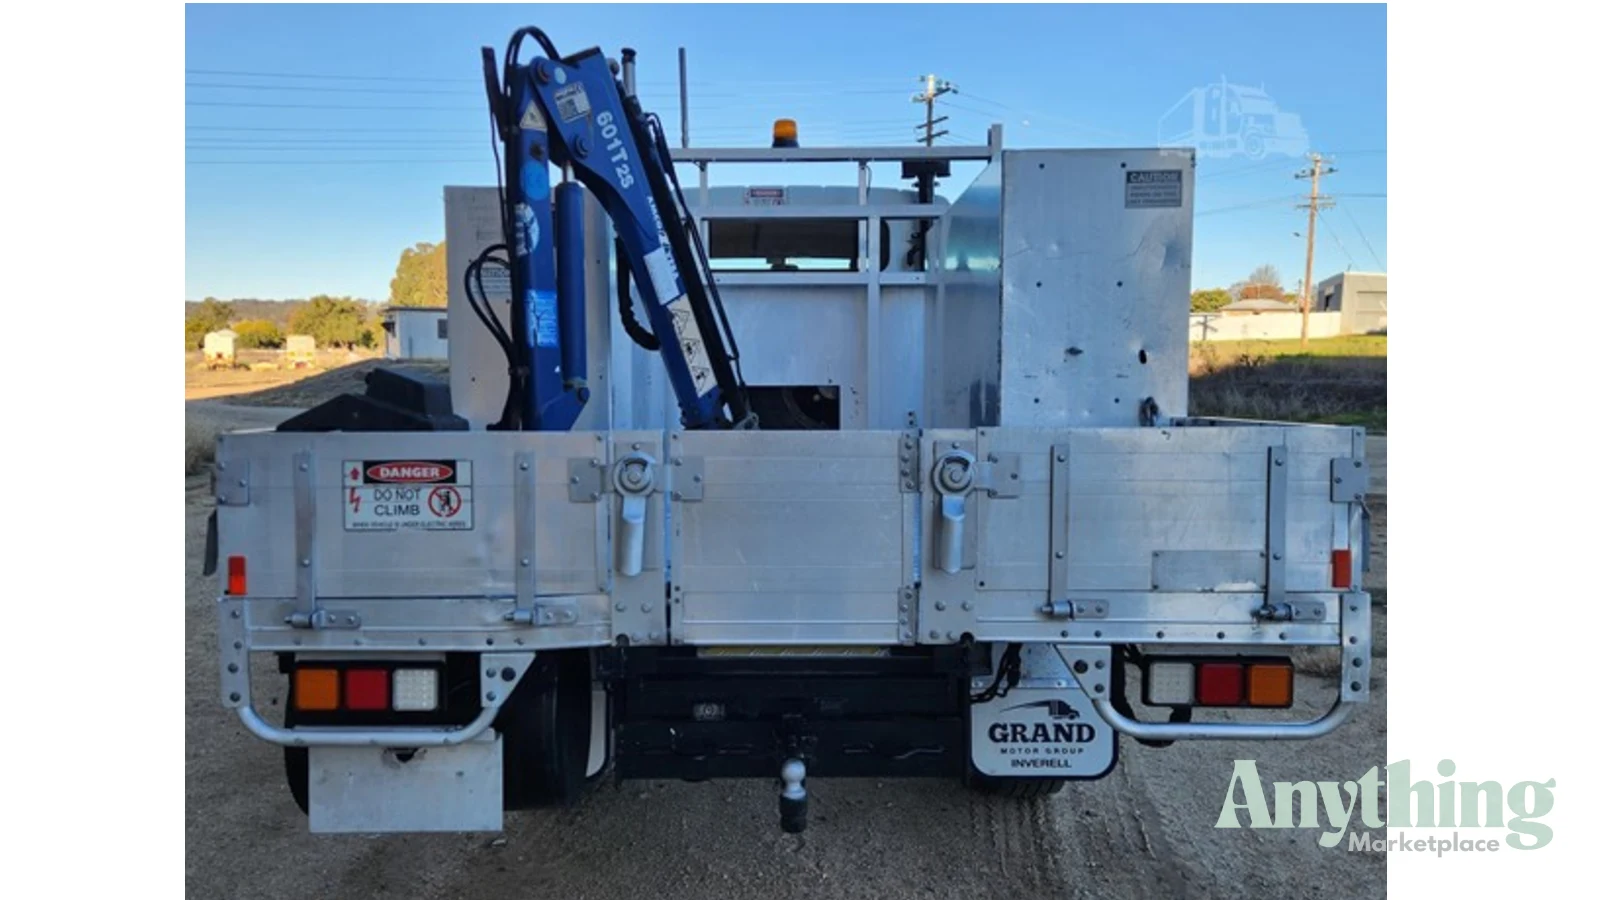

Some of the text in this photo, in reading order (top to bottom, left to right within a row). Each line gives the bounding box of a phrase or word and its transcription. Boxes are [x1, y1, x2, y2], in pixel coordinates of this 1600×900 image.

[380, 466, 440, 479] DANGER
[374, 488, 421, 501] DO NOT
[374, 504, 421, 516] CLIMB
[988, 722, 1096, 743] GRAND
[1000, 747, 1085, 755] MOTOR GROUP
[1011, 759, 1072, 768] INVERELL
